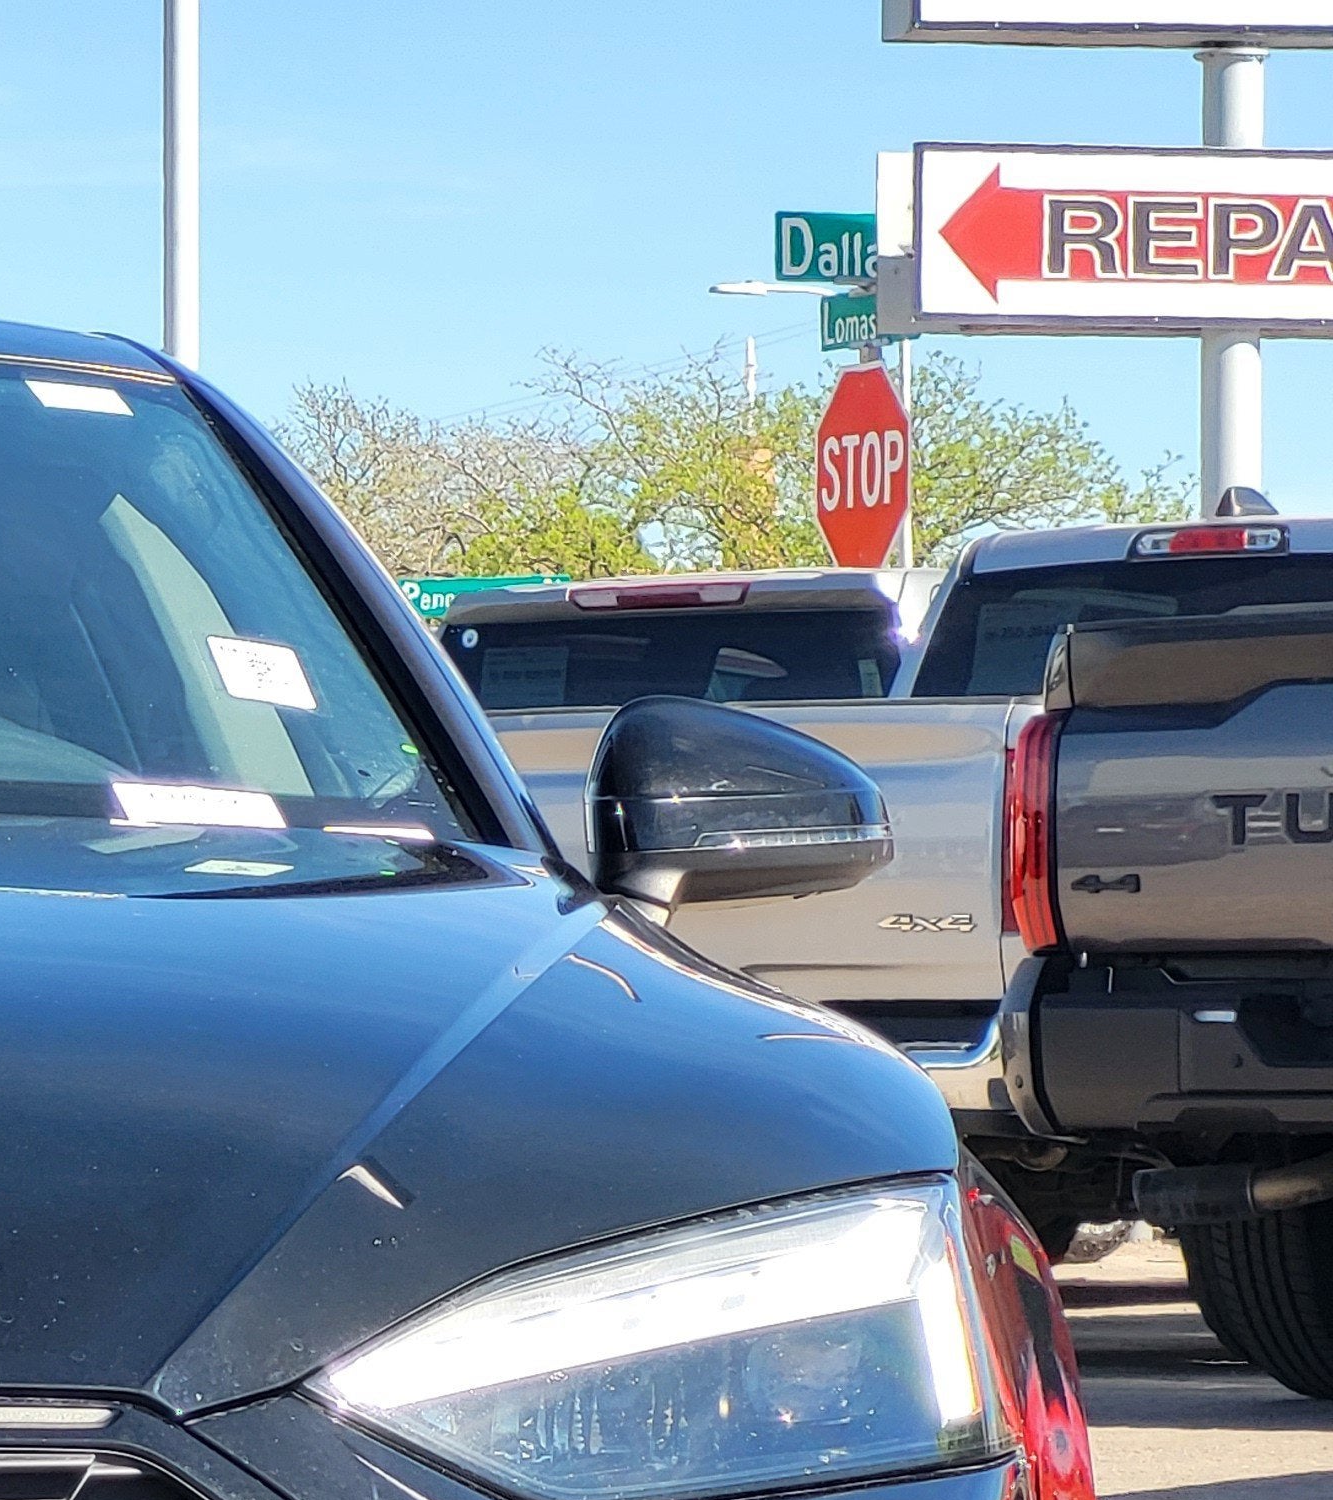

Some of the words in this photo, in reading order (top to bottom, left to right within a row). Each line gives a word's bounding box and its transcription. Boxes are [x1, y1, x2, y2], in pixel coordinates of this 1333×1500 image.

[1042, 194, 1333, 281] REPA
[823, 302, 877, 345] Lomas
[821, 429, 904, 511] STOP
[1211, 792, 1333, 845] TU
